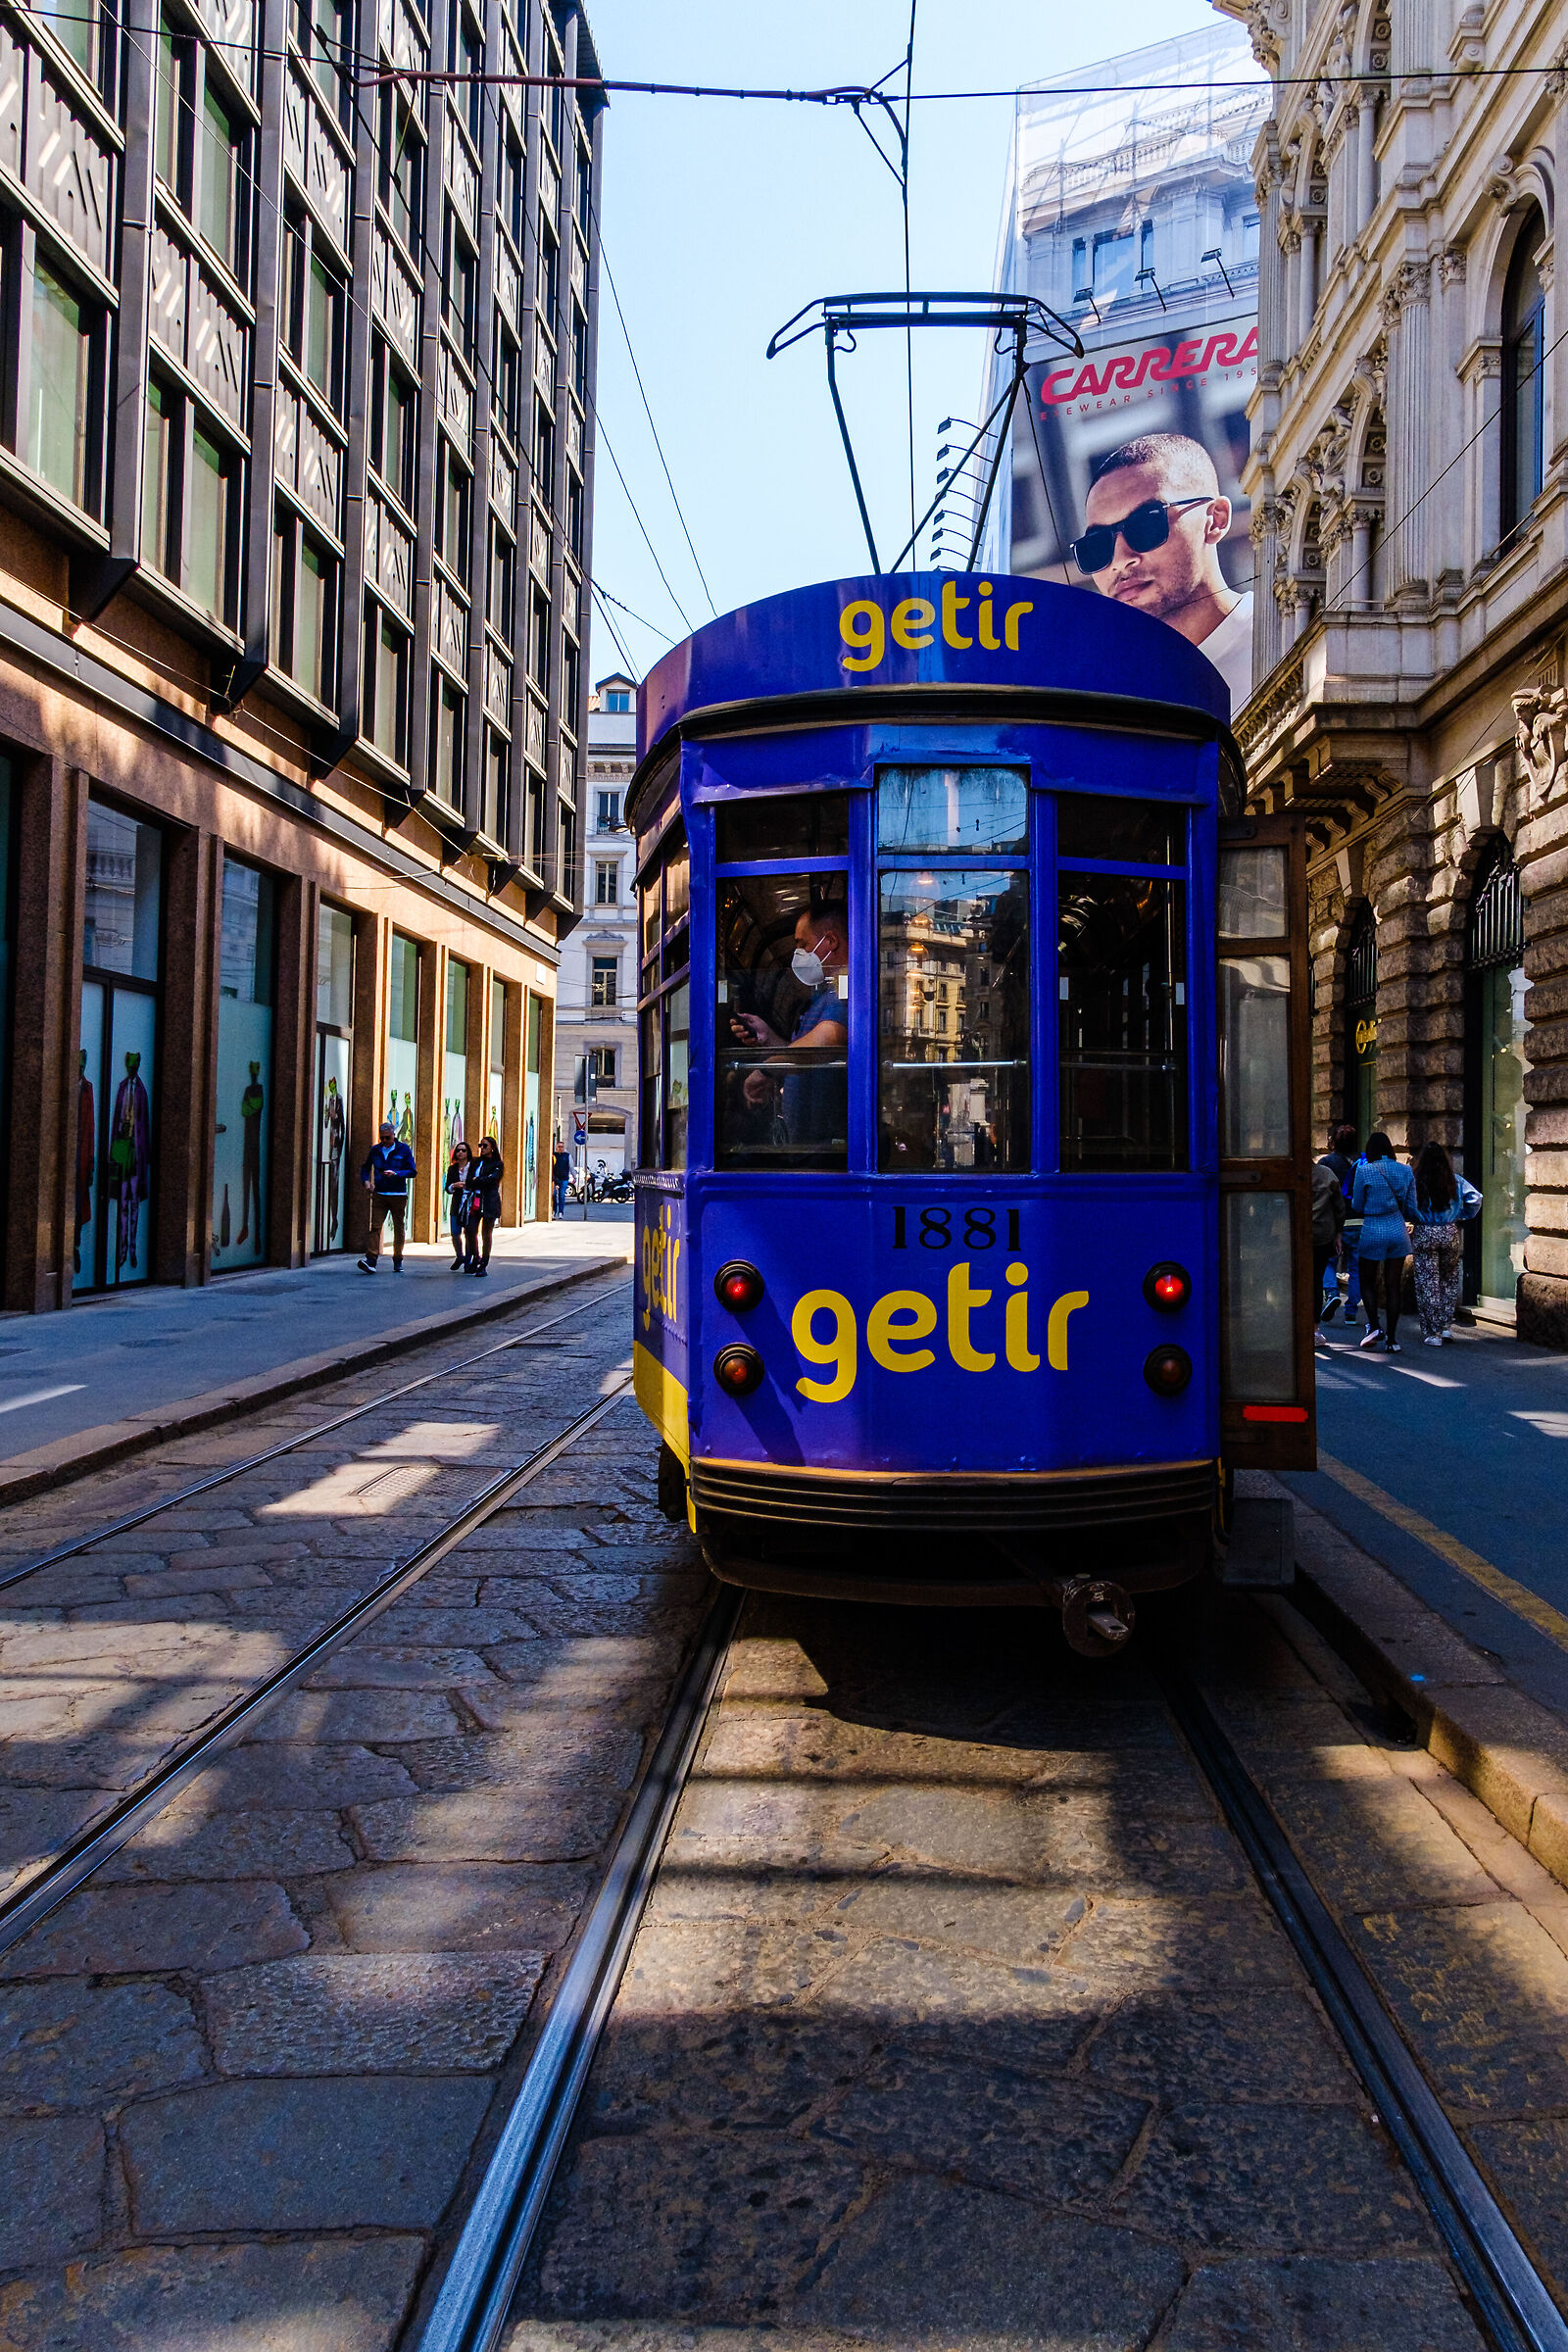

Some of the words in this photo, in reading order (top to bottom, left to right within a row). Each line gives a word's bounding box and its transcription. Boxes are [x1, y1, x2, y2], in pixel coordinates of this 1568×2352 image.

[1041, 326, 1258, 405] CARRERA
[1147, 378, 1207, 398] SINCE
[1224, 367, 1257, 381] 195
[839, 580, 1034, 672] getir
[642, 1203, 680, 1332] getir
[892, 1205, 1021, 1251] 1881
[791, 1262, 1090, 1403] getir
